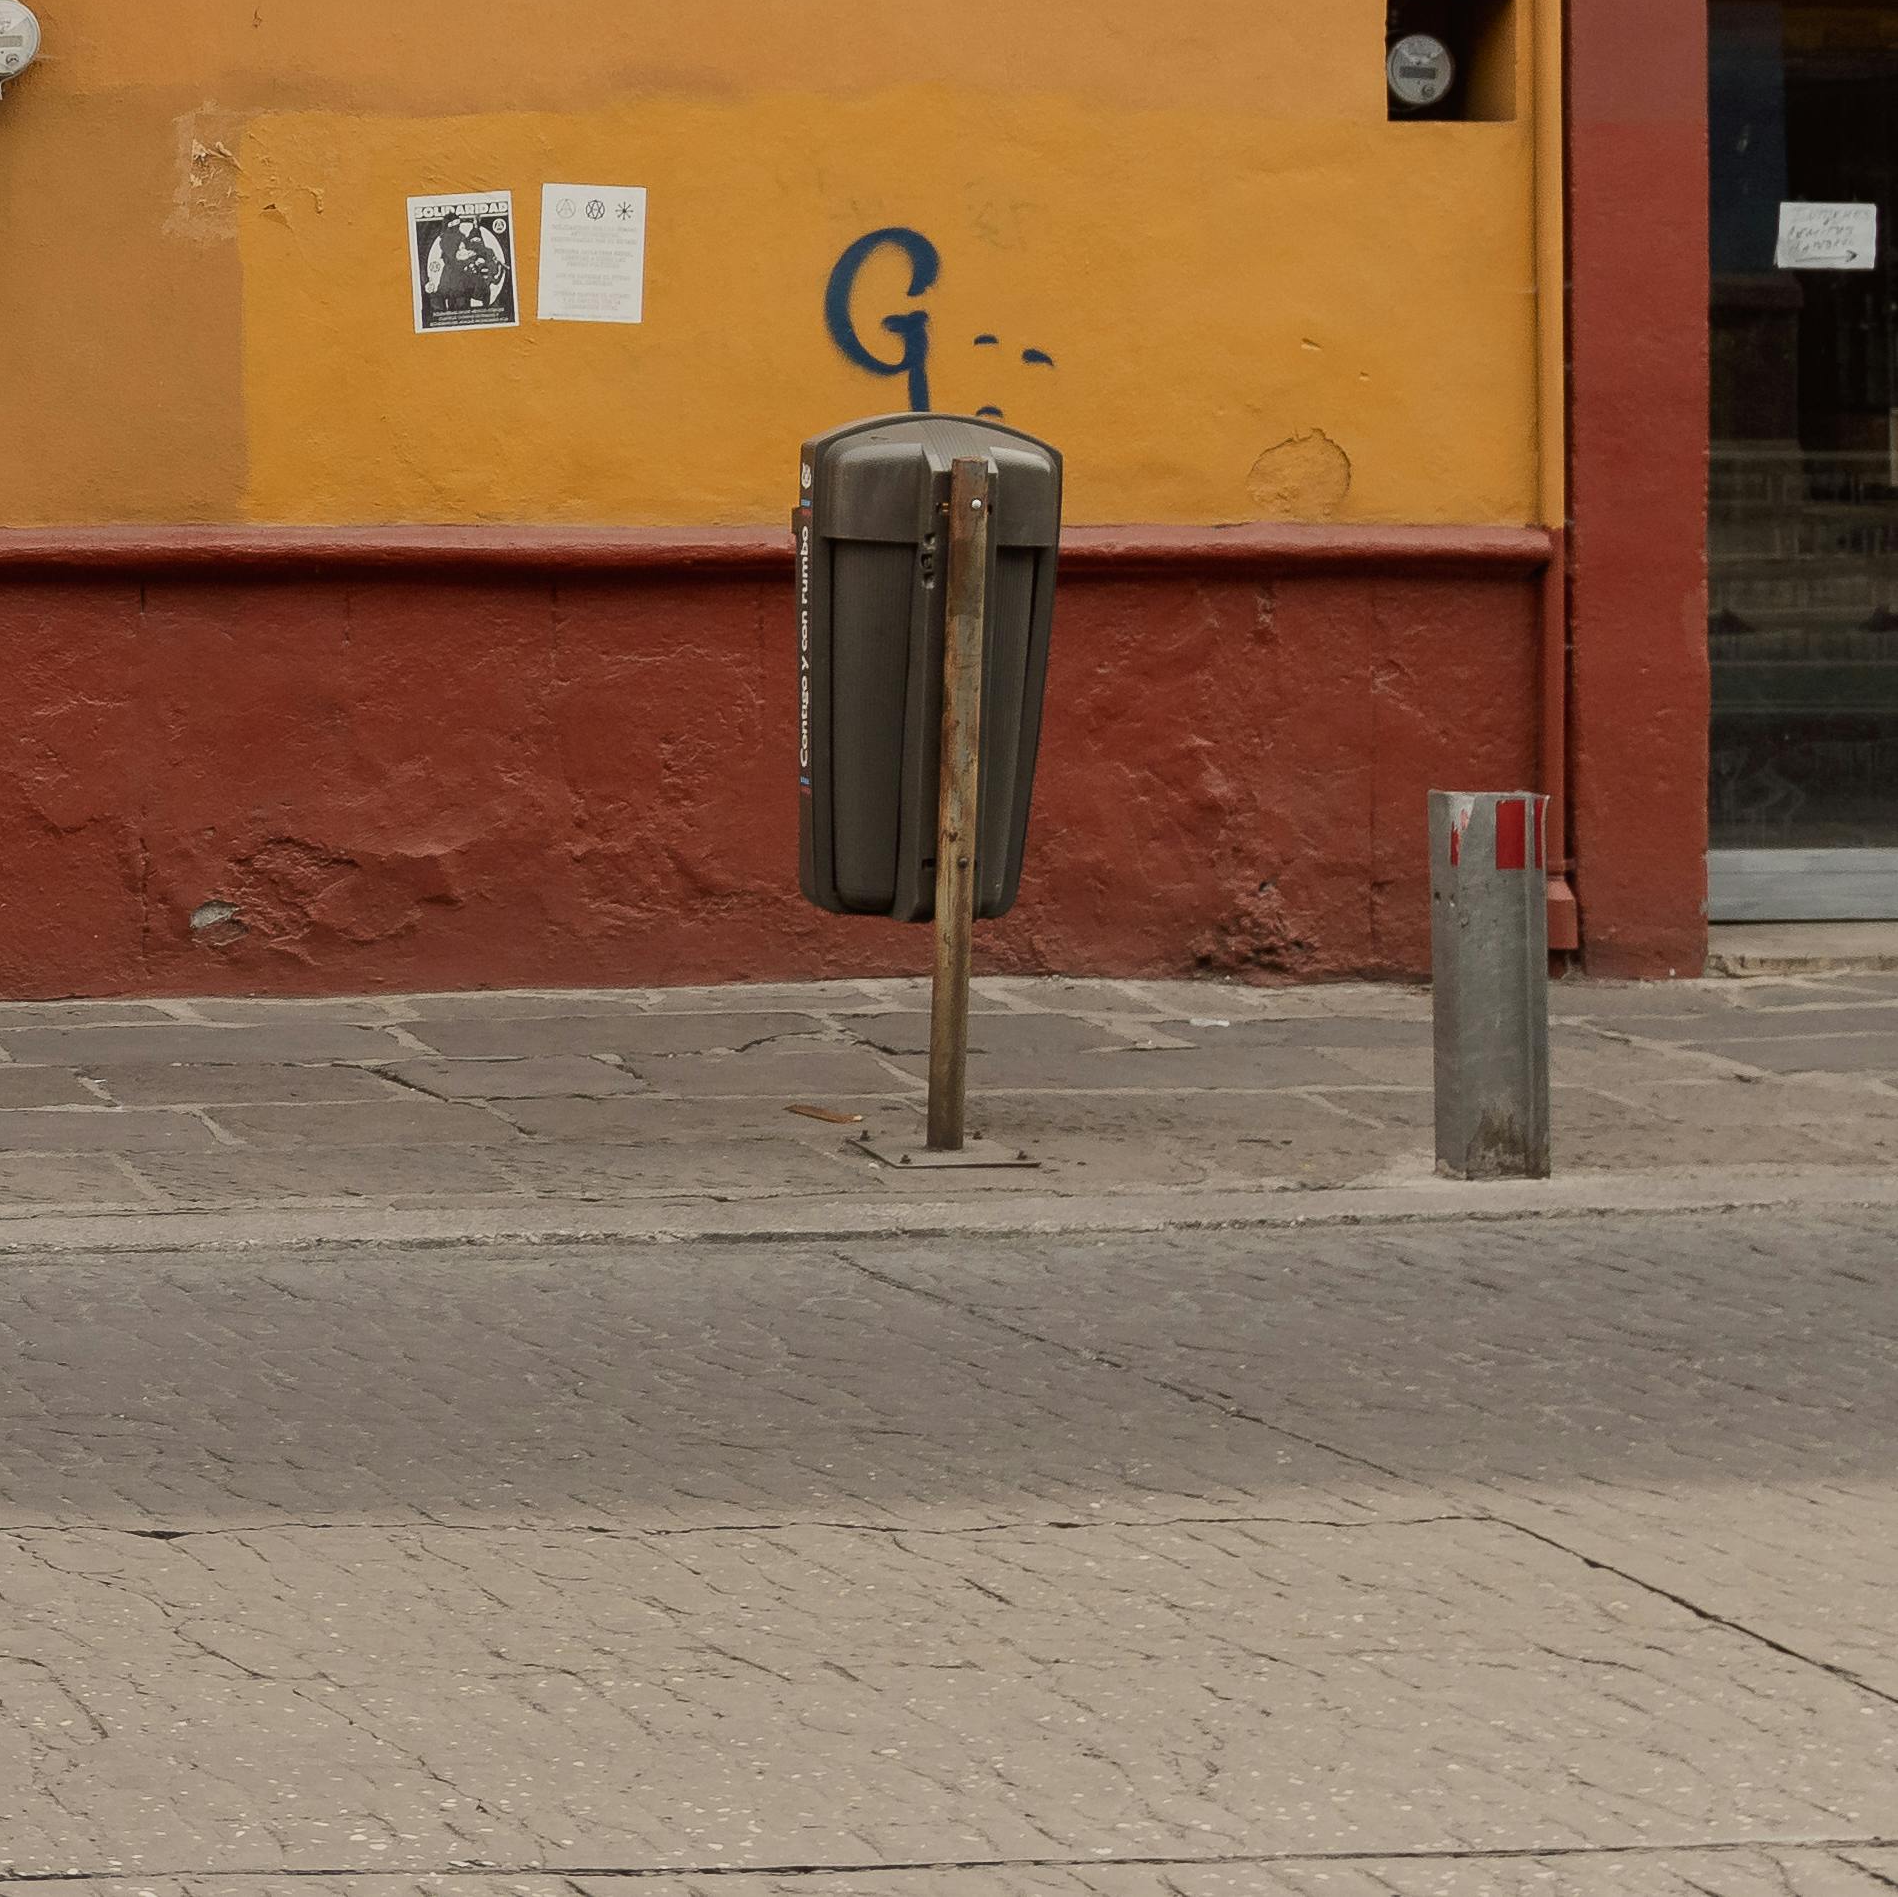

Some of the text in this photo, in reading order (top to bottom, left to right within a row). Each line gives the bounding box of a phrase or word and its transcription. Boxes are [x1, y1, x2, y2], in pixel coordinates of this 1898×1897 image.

[414, 201, 509, 219] SOLIDARIDAD
[801, 526, 809, 604] rumbo
[801, 655, 809, 670] y
[800, 676, 809, 767] Contigo
